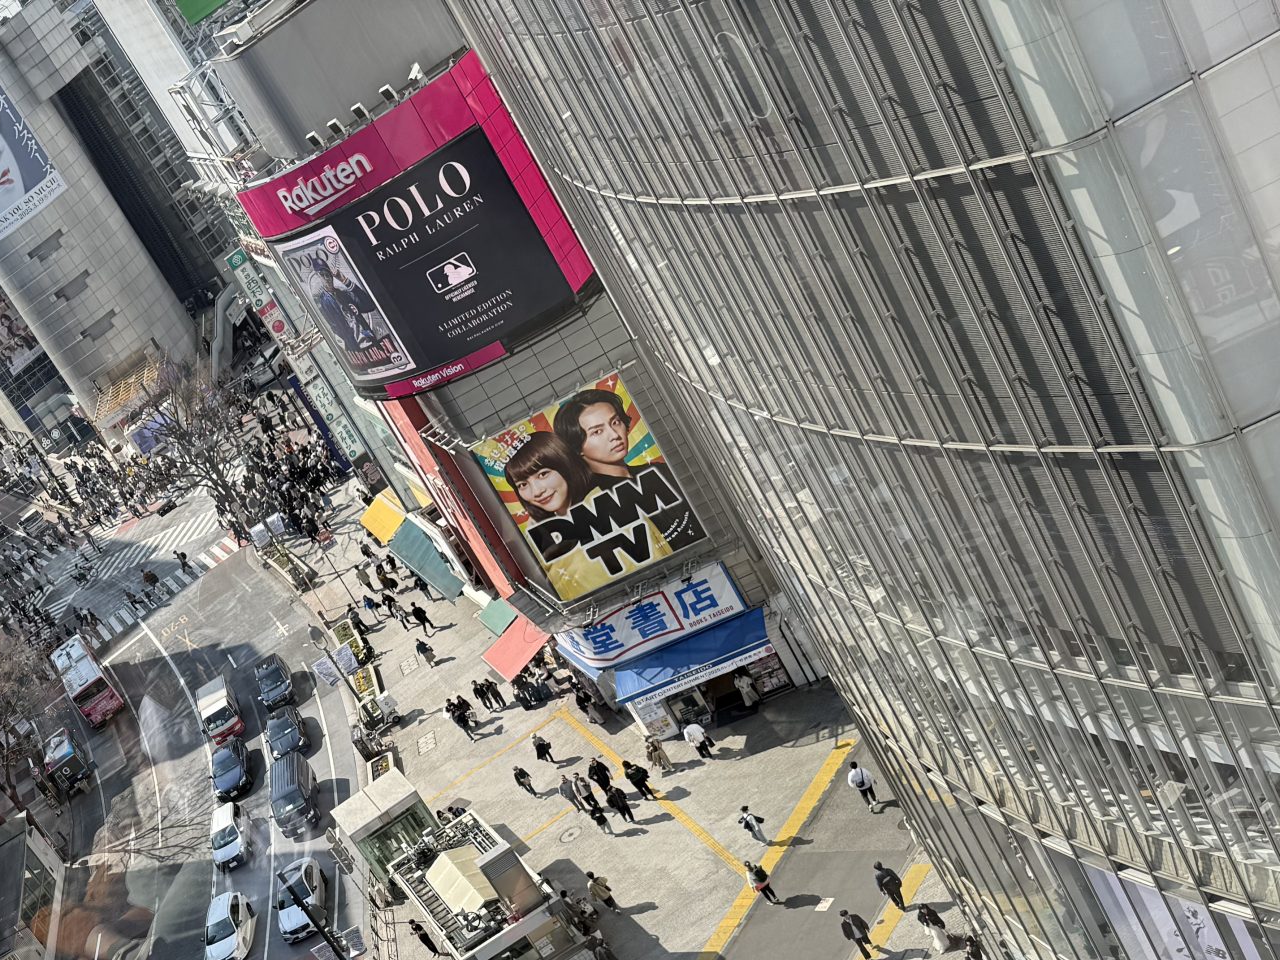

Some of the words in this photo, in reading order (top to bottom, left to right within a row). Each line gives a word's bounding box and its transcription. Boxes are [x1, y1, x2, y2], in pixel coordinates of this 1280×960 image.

[276, 152, 373, 215] Rakuten
[355, 160, 471, 246] POLO
[8, 204, 23, 217] YOU
[23, 195, 35, 207] SO
[375, 232, 421, 261] RALPH
[425, 194, 484, 235] LAUREN
[443, 308, 477, 329] LIMITED
[477, 289, 513, 312] EDITION
[447, 299, 513, 338] COLLABORATION
[412, 371, 441, 388] Rakuten
[441, 362, 465, 380] Vision
[526, 467, 683, 564] DMM
[583, 520, 652, 576] TV
[688, 616, 708, 629] BOOKS
[708, 604, 735, 623] TAISEIDO
[673, 663, 714, 682] TAISEIDO
